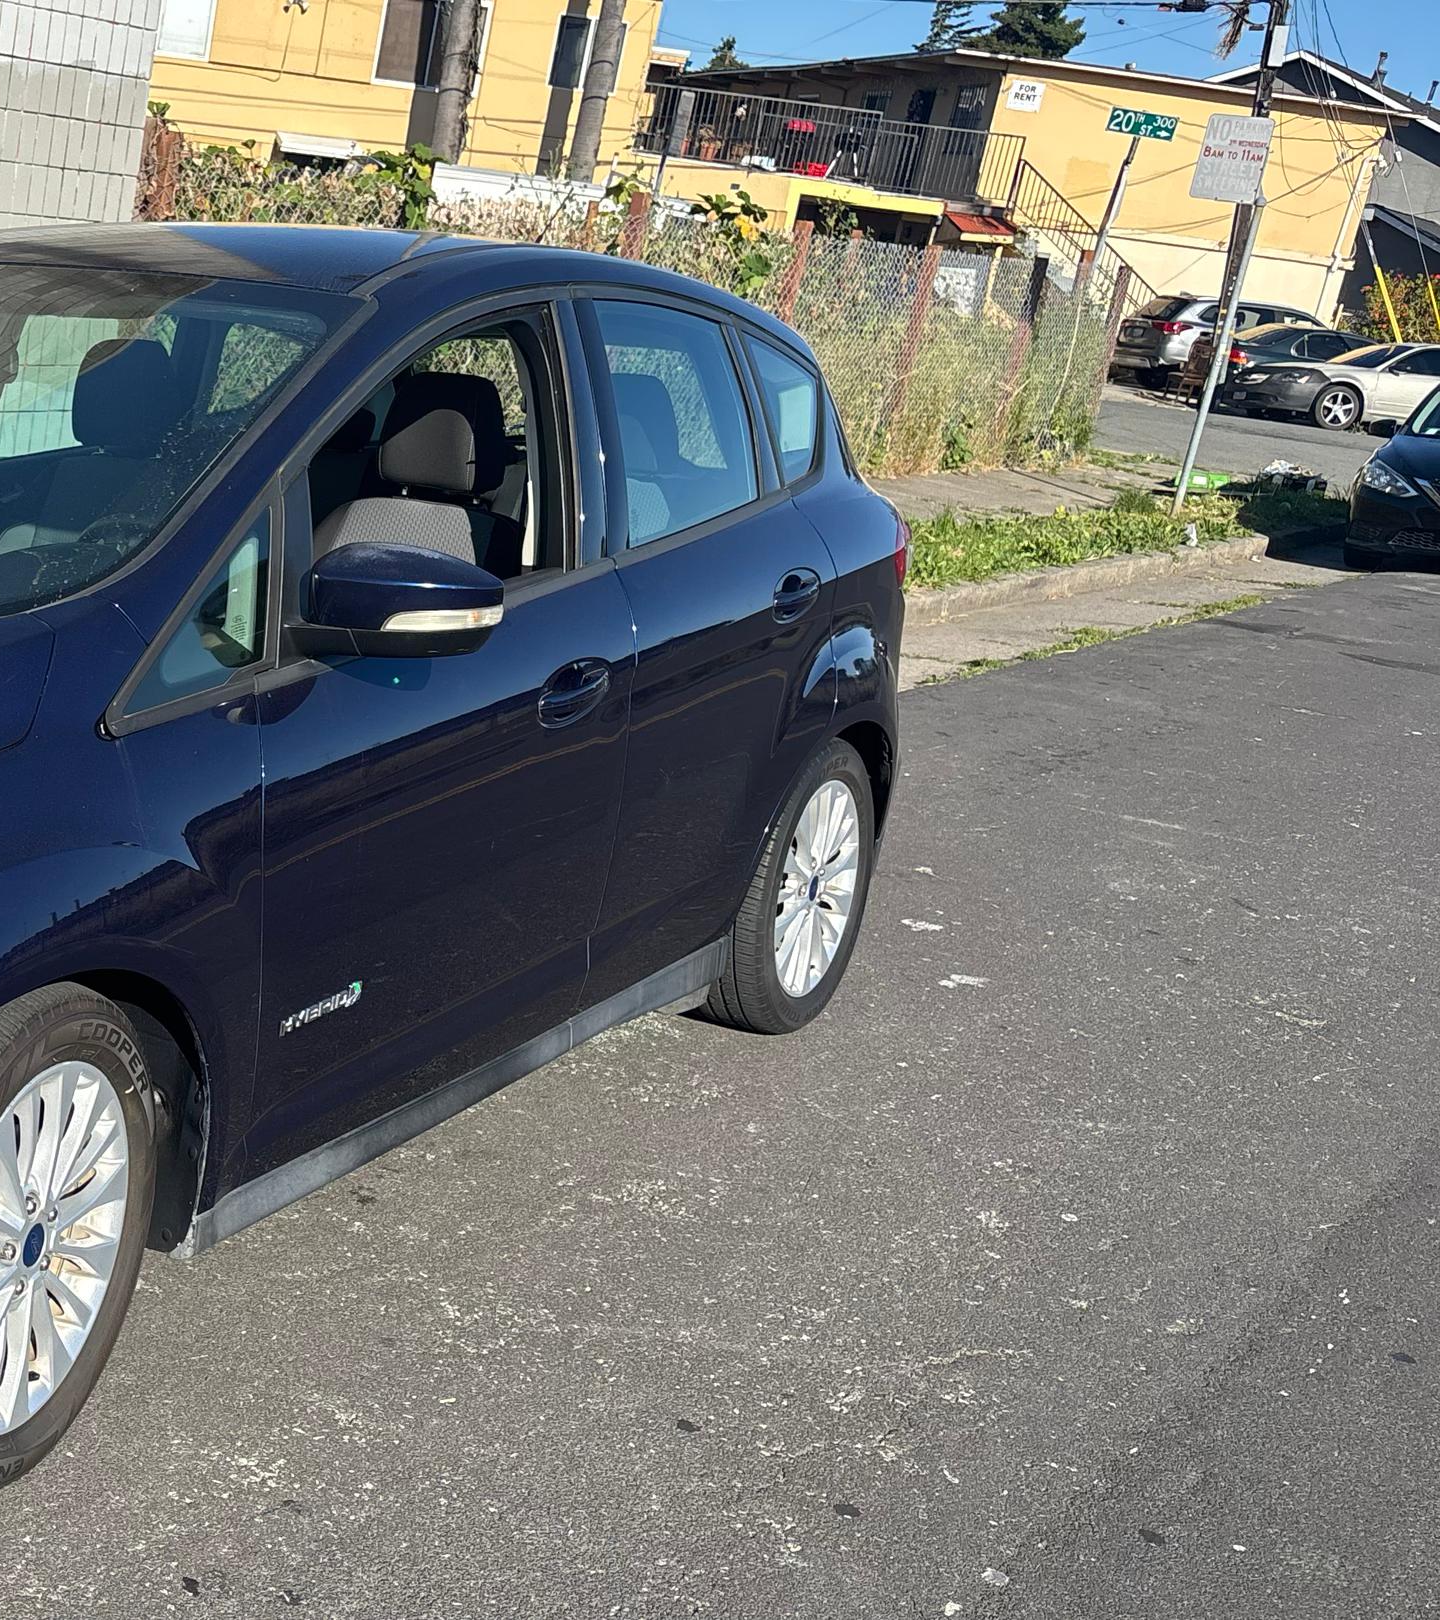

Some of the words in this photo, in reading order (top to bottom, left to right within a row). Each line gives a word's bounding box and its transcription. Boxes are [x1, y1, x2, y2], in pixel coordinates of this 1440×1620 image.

[1014, 92, 1037, 102] RENT
[1019, 84, 1037, 93] FOR
[1153, 116, 1176, 129] 300
[1207, 117, 1233, 141] NO
[1203, 146, 1224, 158] 8AM
[1228, 151, 1238, 160] TO
[1241, 149, 1263, 163] 11AM
[1203, 160, 1257, 177] STREET
[279, 990, 349, 1037] HYBRID
[80, 1022, 149, 1095] COOPER
